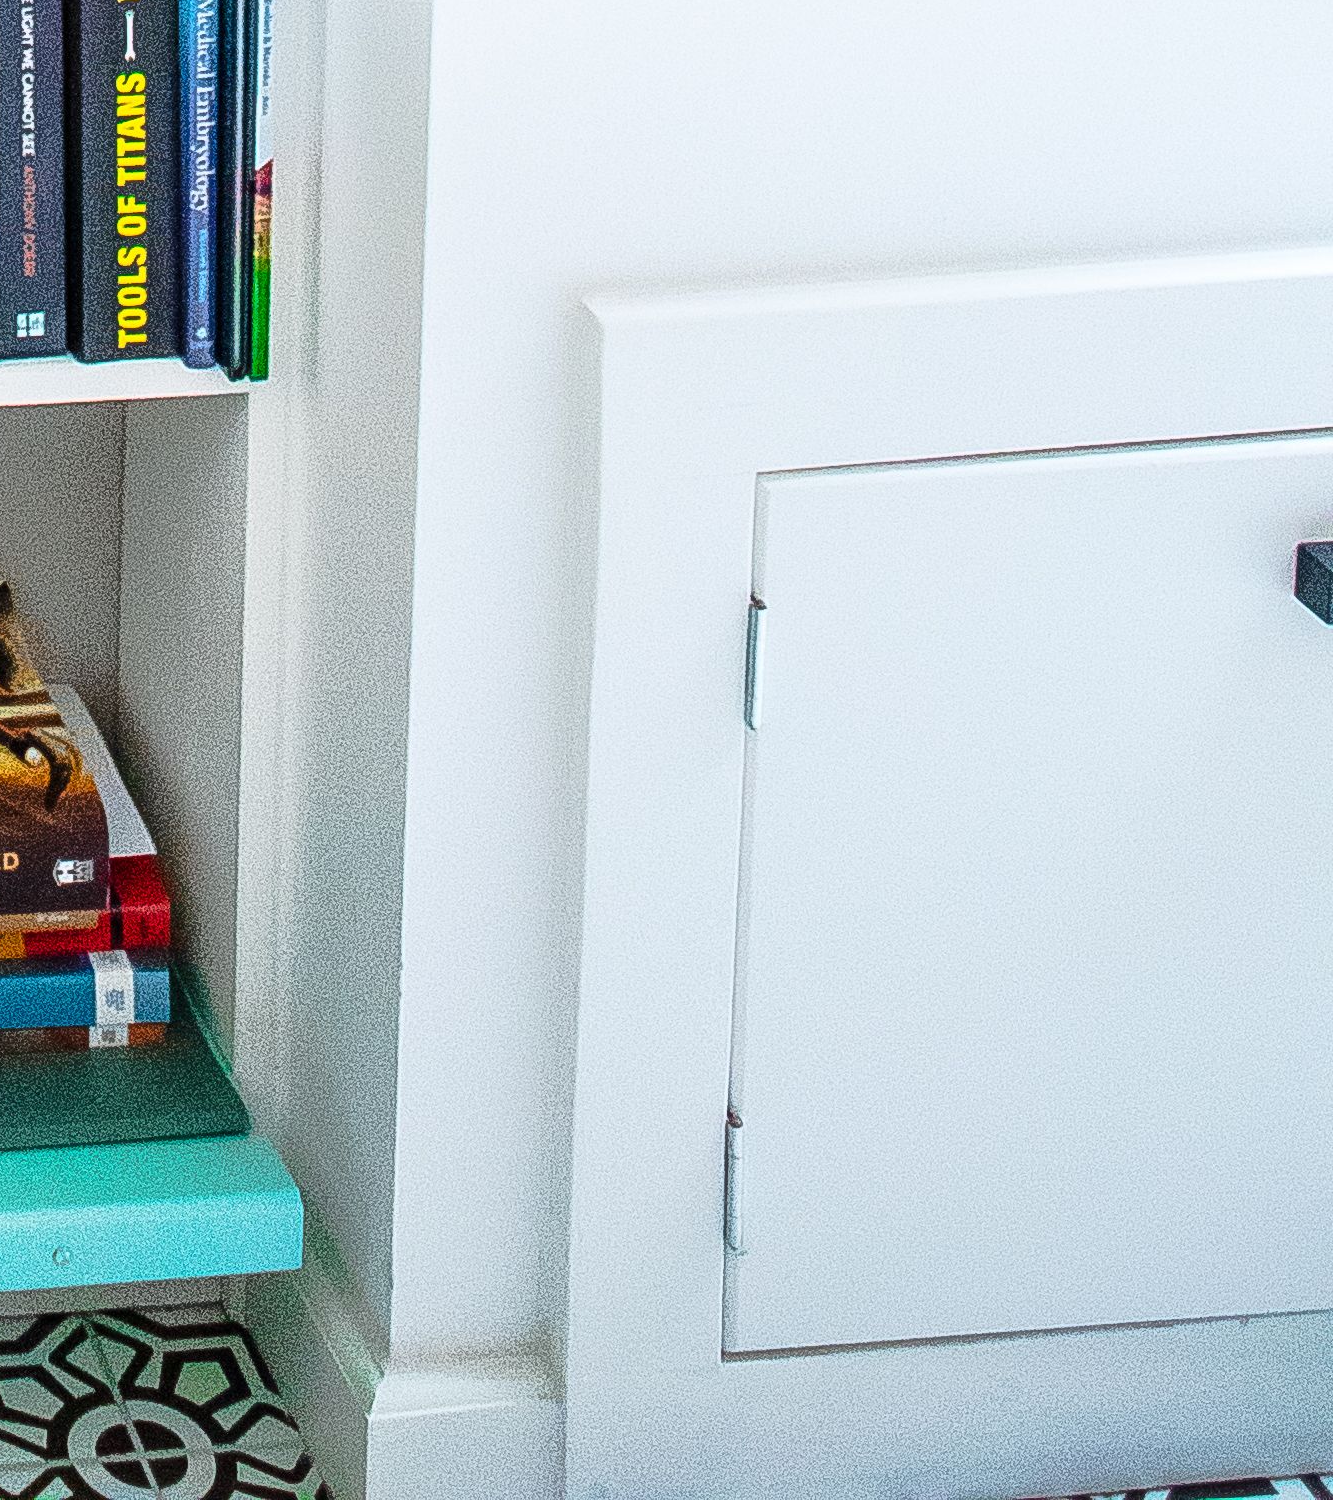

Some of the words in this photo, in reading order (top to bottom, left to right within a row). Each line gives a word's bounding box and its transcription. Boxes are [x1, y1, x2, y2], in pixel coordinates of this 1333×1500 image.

[20, 7, 35, 46] LIGHT
[20, 73, 35, 131] CANNOT
[115, 72, 146, 187] TITANS
[189, 85, 216, 214] Embryology
[117, 196, 148, 236] OF
[117, 246, 148, 349] TOOLS
